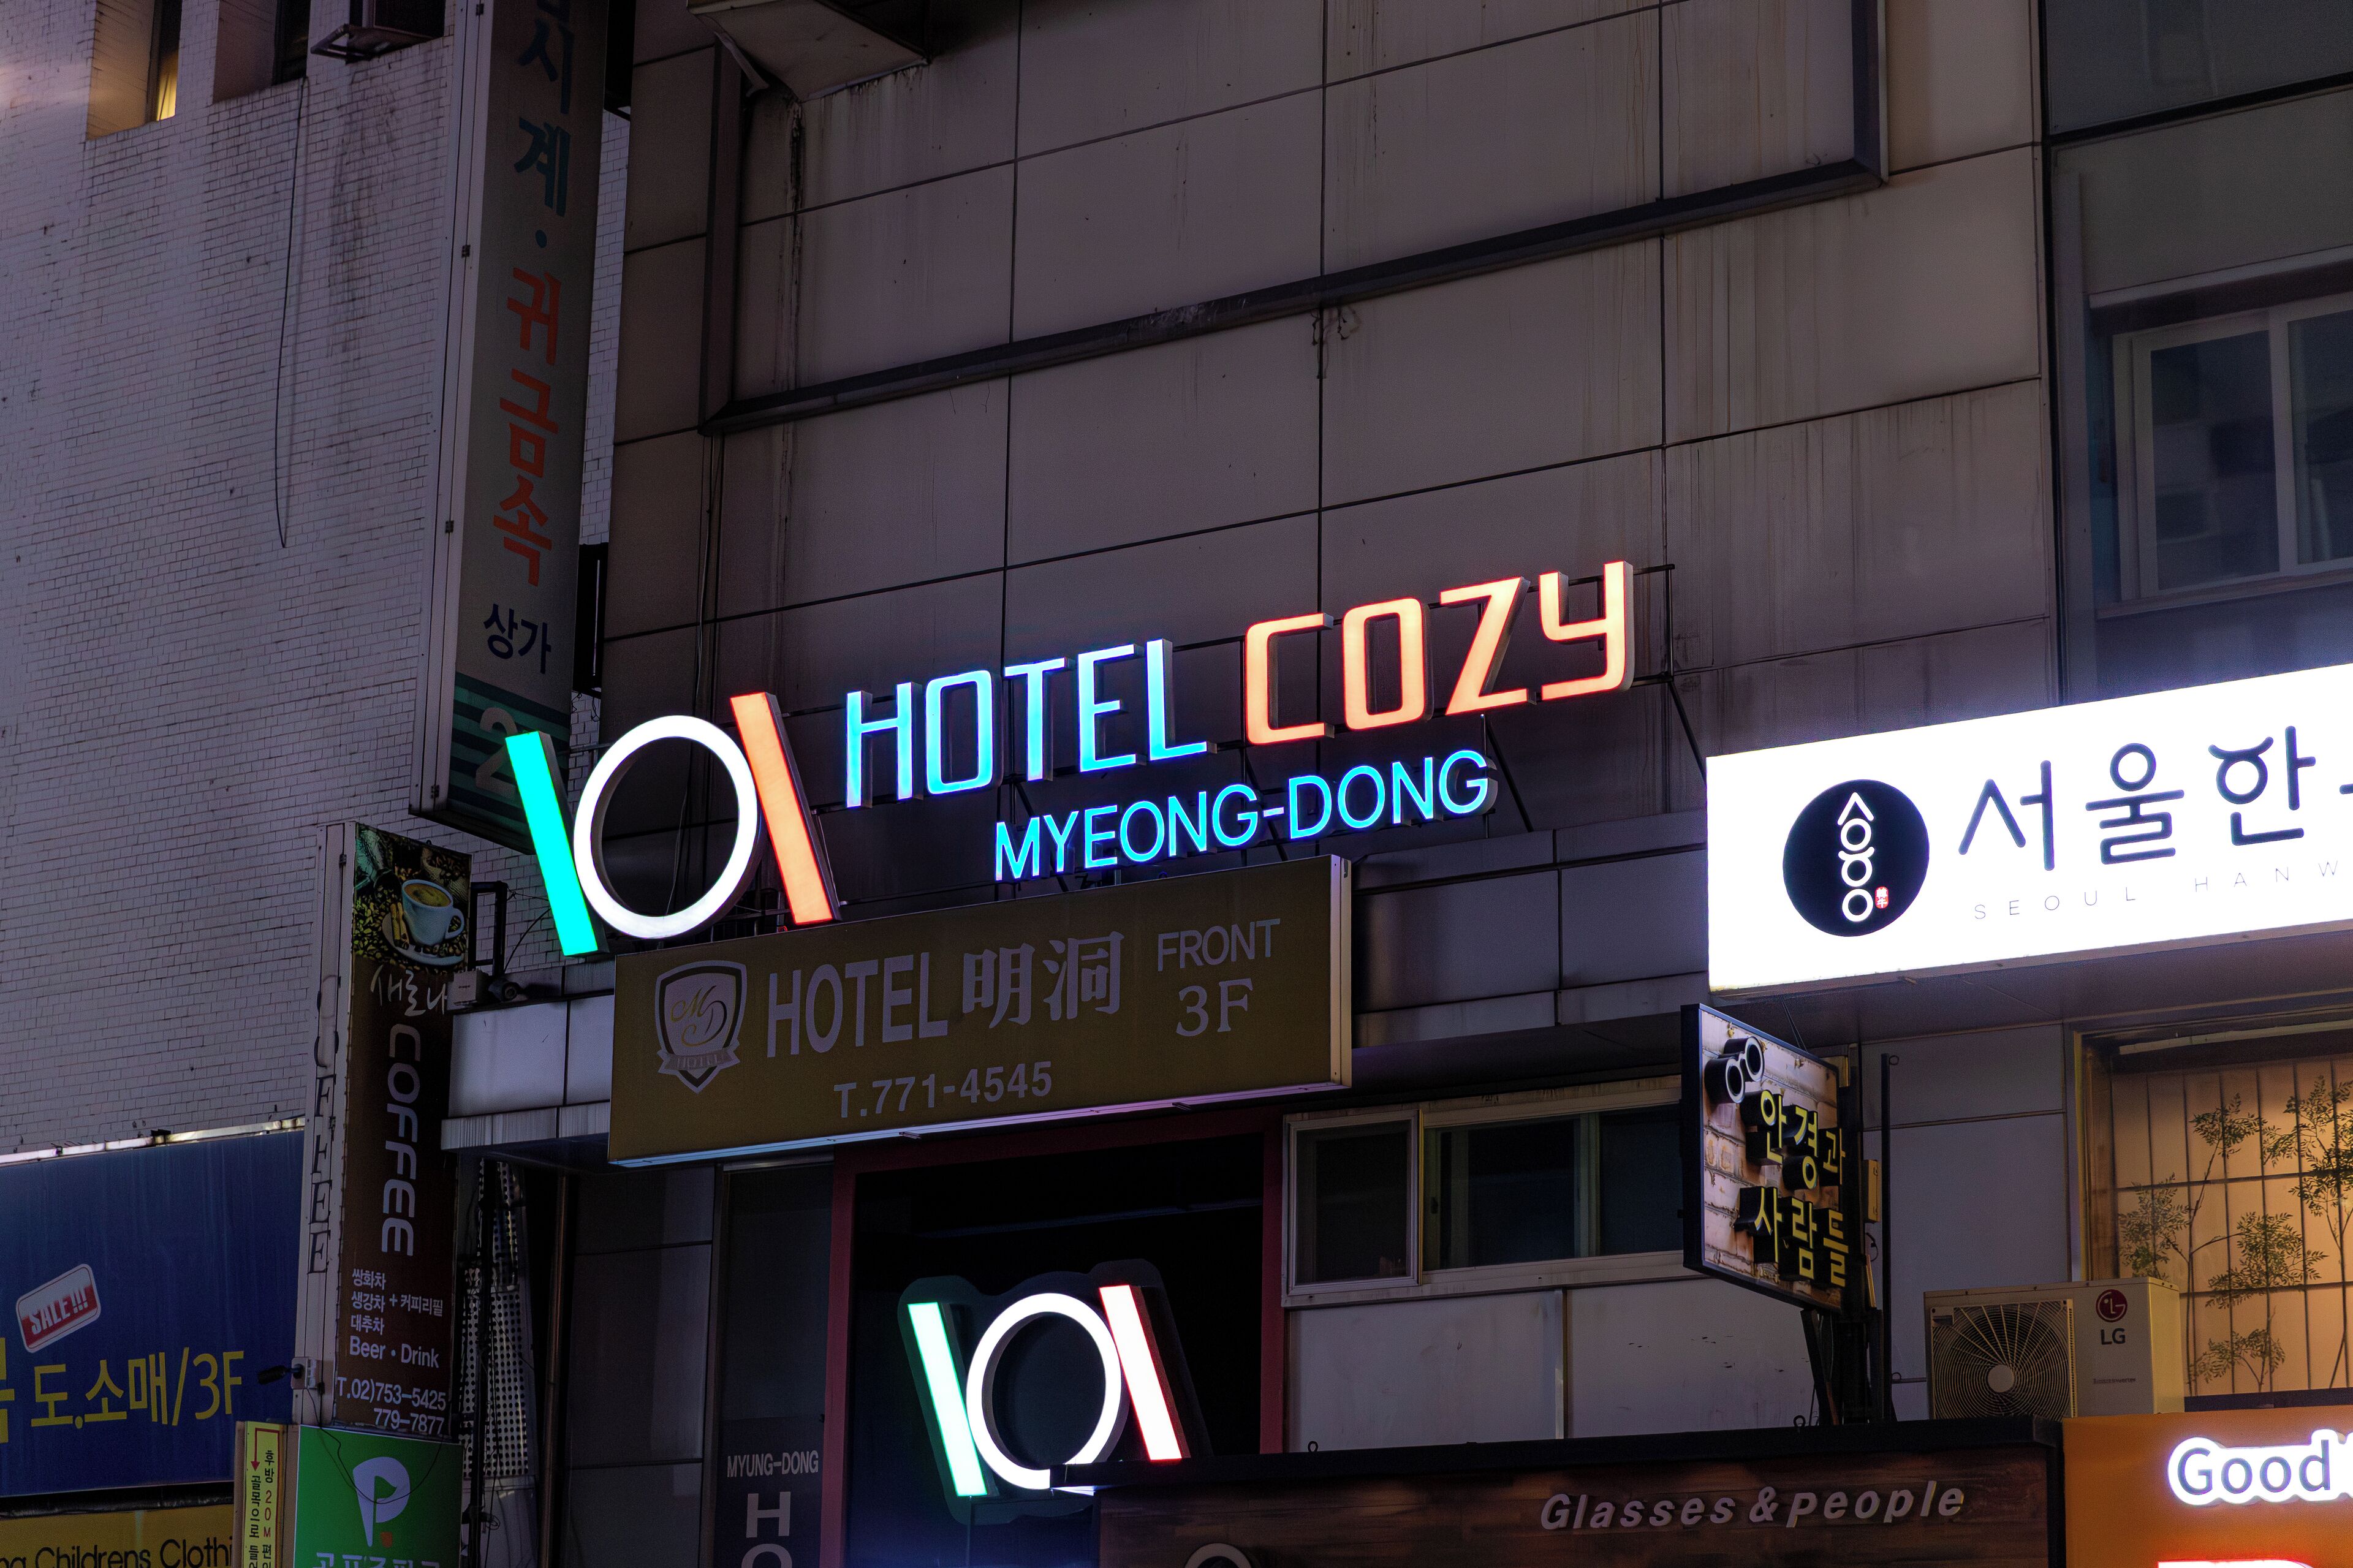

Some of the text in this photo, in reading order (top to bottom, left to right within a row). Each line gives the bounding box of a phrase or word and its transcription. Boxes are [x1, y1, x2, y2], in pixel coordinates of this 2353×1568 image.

[513, 0, 574, 218] 시계
[493, 267, 562, 587] 귀금속
[483, 604, 551, 674] 상가
[846, 560, 1627, 809] HOTEL COZY
[994, 749, 1490, 881] MYEONG-DONG
[1959, 725, 2353, 872] 서울한
[1974, 860, 2338, 920] SEOUL HANW
[1158, 918, 1281, 972] FRONT
[767, 931, 1125, 1058] HOTEL 明洞
[1175, 978, 1254, 1037] 3F
[833, 1060, 1053, 1118] T.771-4545
[381, 1023, 422, 1257] COFFEE
[1760, 1089, 1846, 1189] 안경과
[1754, 1186, 1849, 1287] 사람들
[351, 1290, 385, 1313] 생강차
[400, 1294, 444, 1317] 커피리필
[352, 1268, 386, 1290] 쌍화차
[29, 1288, 88, 1335] SALE!!!
[350, 1314, 385, 1335] 대추차
[2101, 1327, 2126, 1345] LG
[349, 1335, 387, 1360] Beer
[401, 1343, 439, 1368] Drink
[337, 1376, 447, 1411] T.02)753-5425
[373, 1407, 445, 1435] 779-7877
[727, 1450, 819, 1478] MYUNG-DONG
[2177, 1439, 2331, 1496] Good
[1540, 1493, 1736, 1530] Glasses
